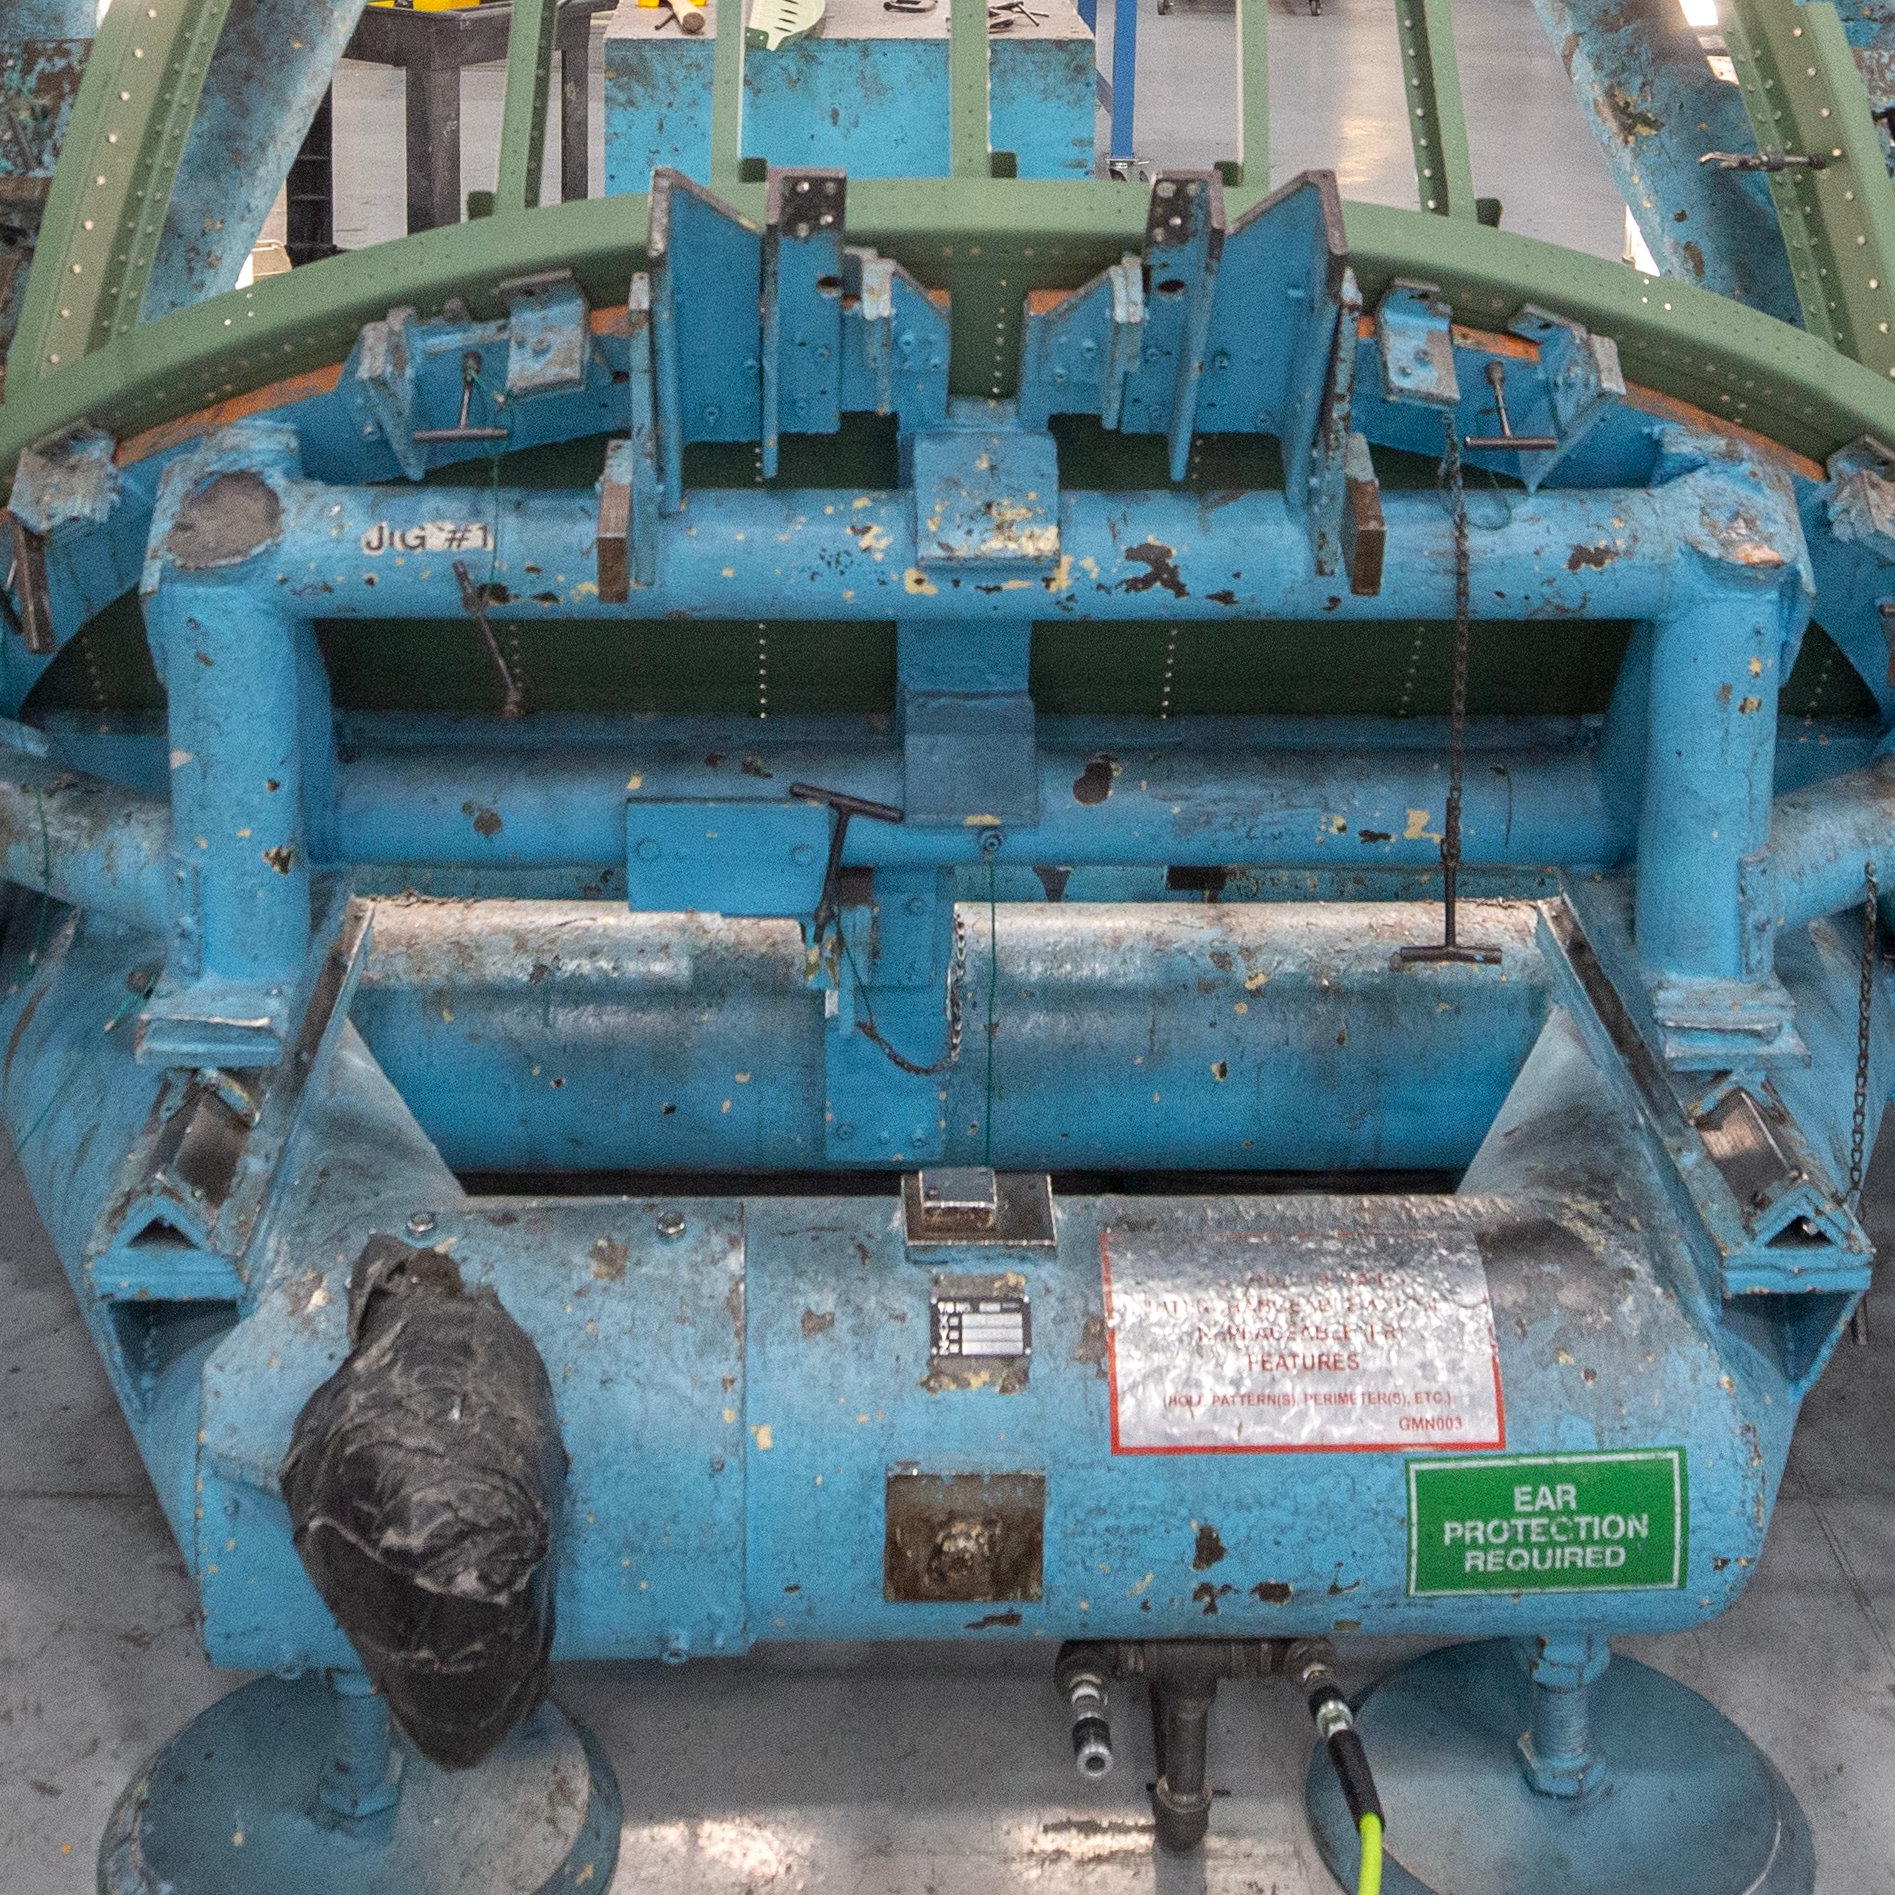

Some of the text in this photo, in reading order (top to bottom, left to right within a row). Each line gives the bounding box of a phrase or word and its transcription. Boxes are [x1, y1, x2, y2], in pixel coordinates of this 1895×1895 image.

[363, 523, 490, 551] JIG #1
[1248, 1351, 1361, 1372] FEATURES
[1414, 1391, 1453, 1406] ETC.)
[1398, 1415, 1463, 1431] GMN003
[1512, 1483, 1578, 1513] EAR
[1443, 1512, 1650, 1546] PROTECTION
[1464, 1544, 1627, 1574] REQUIRED
